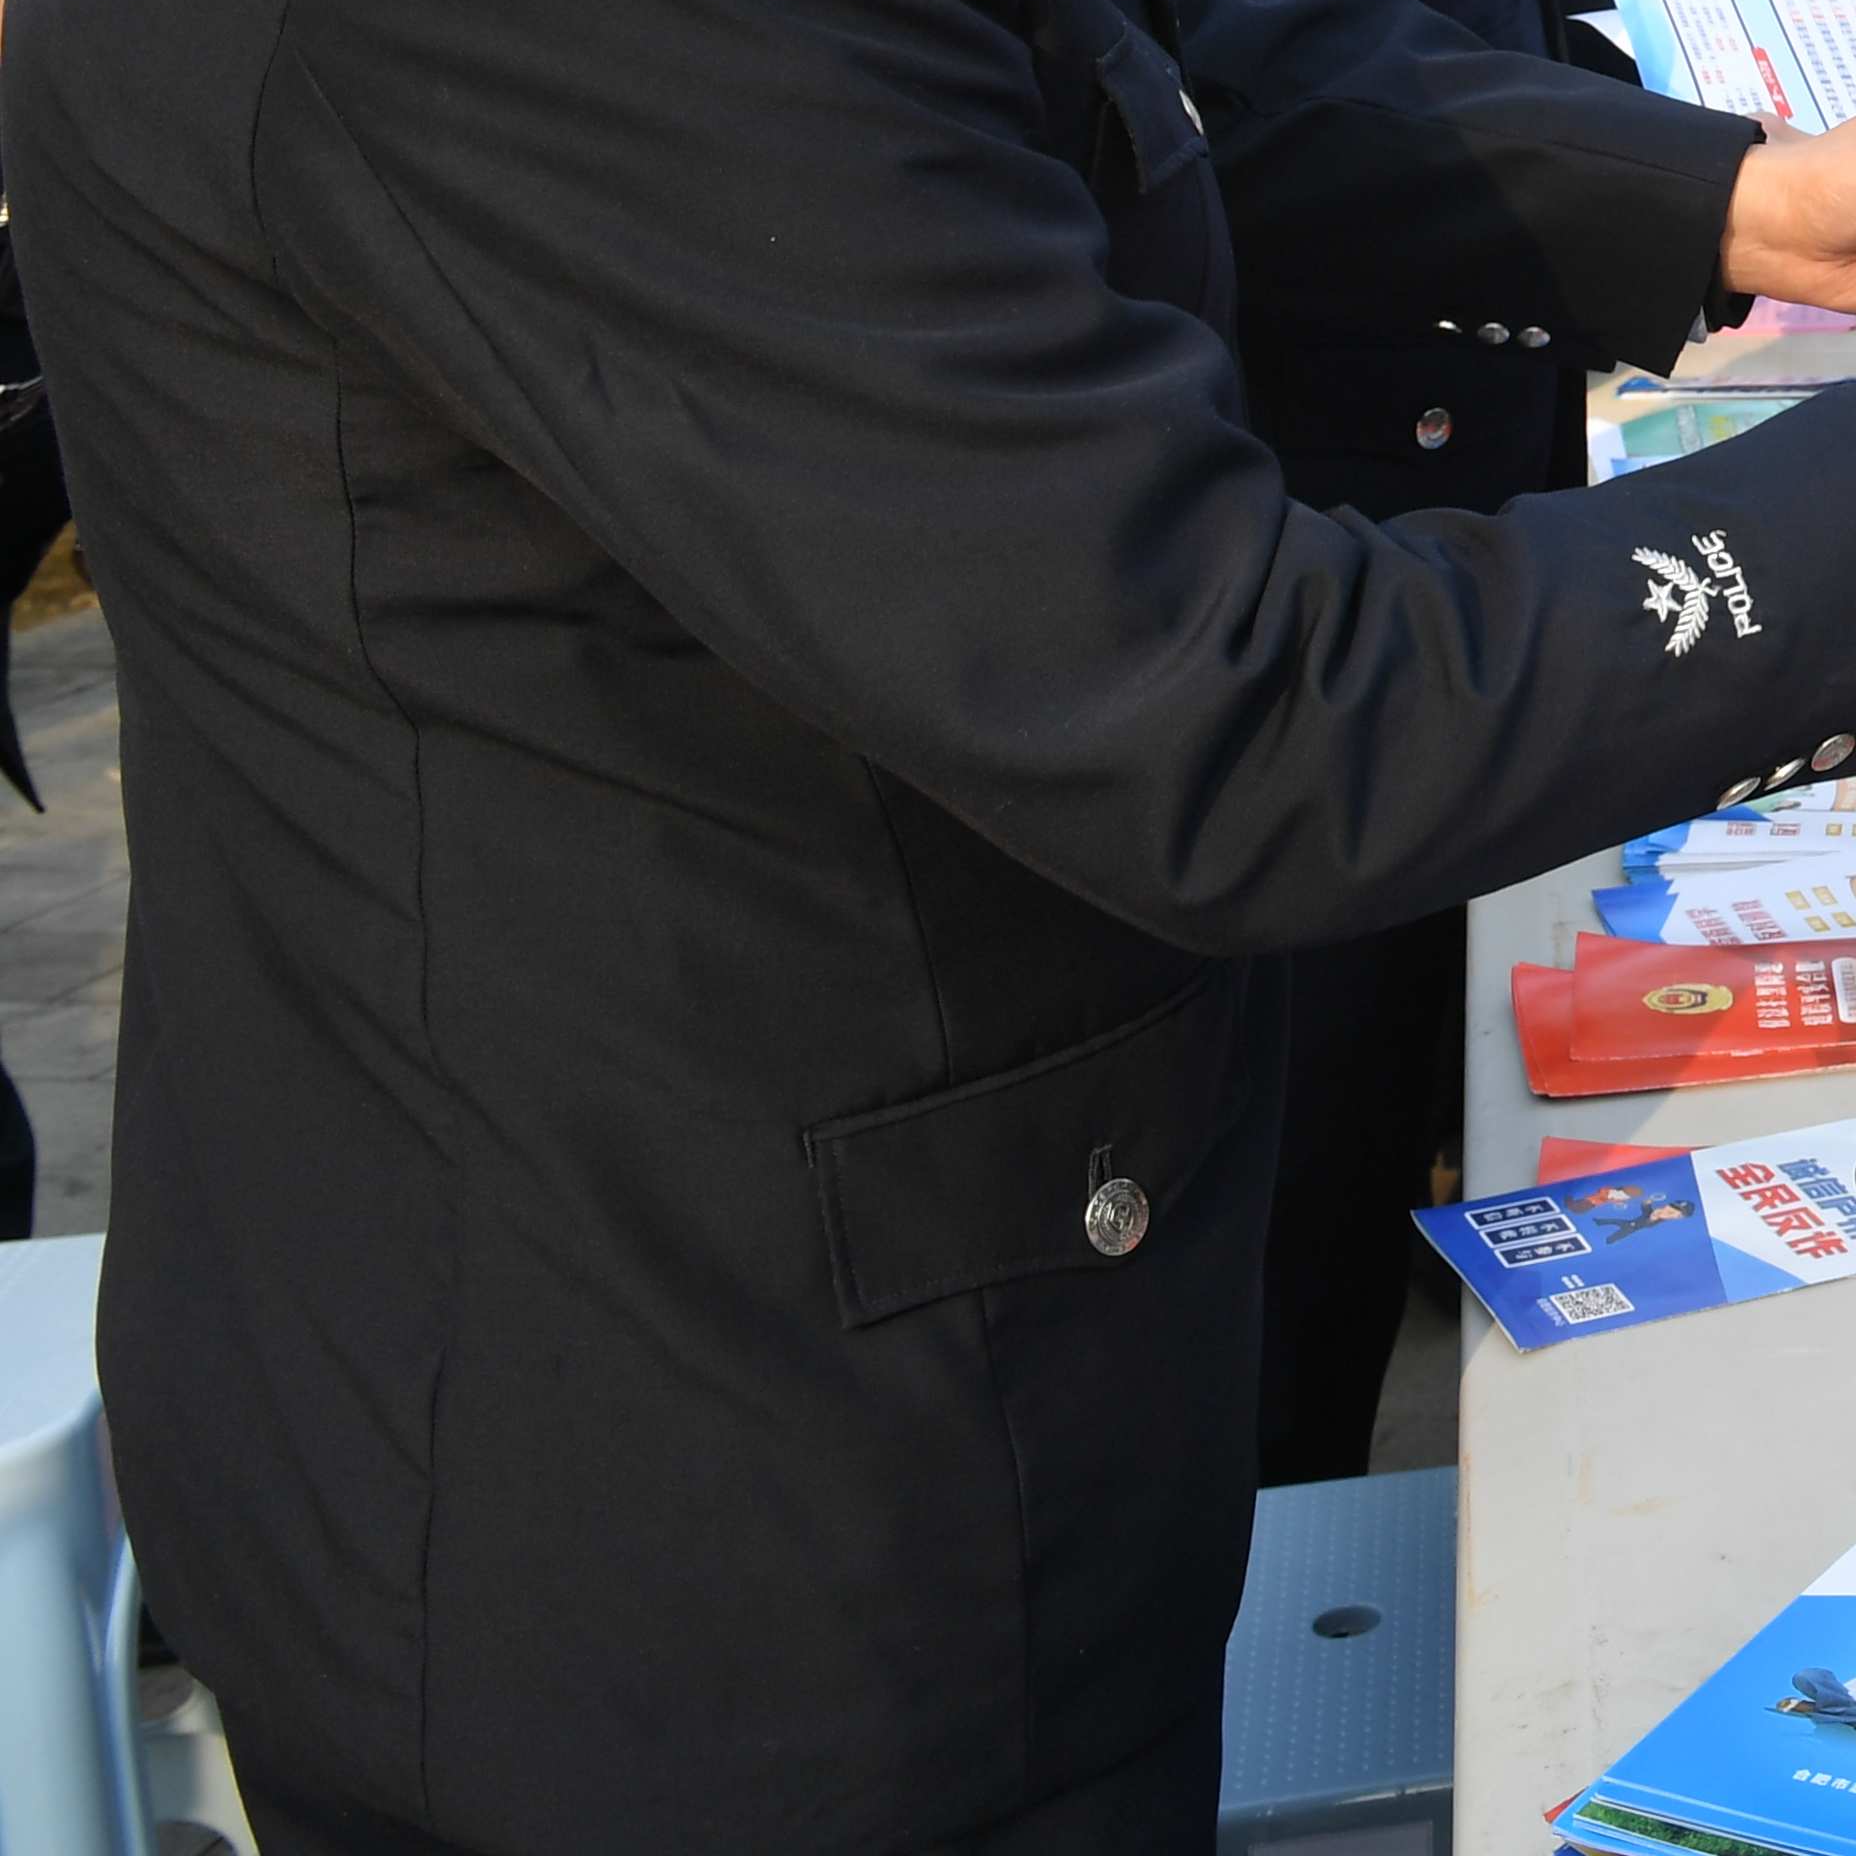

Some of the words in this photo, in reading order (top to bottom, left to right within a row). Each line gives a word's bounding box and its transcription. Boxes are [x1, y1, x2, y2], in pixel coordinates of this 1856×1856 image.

[1692, 529, 1762, 638] POLICE
[1714, 1162, 1850, 1259] 全民反诈
